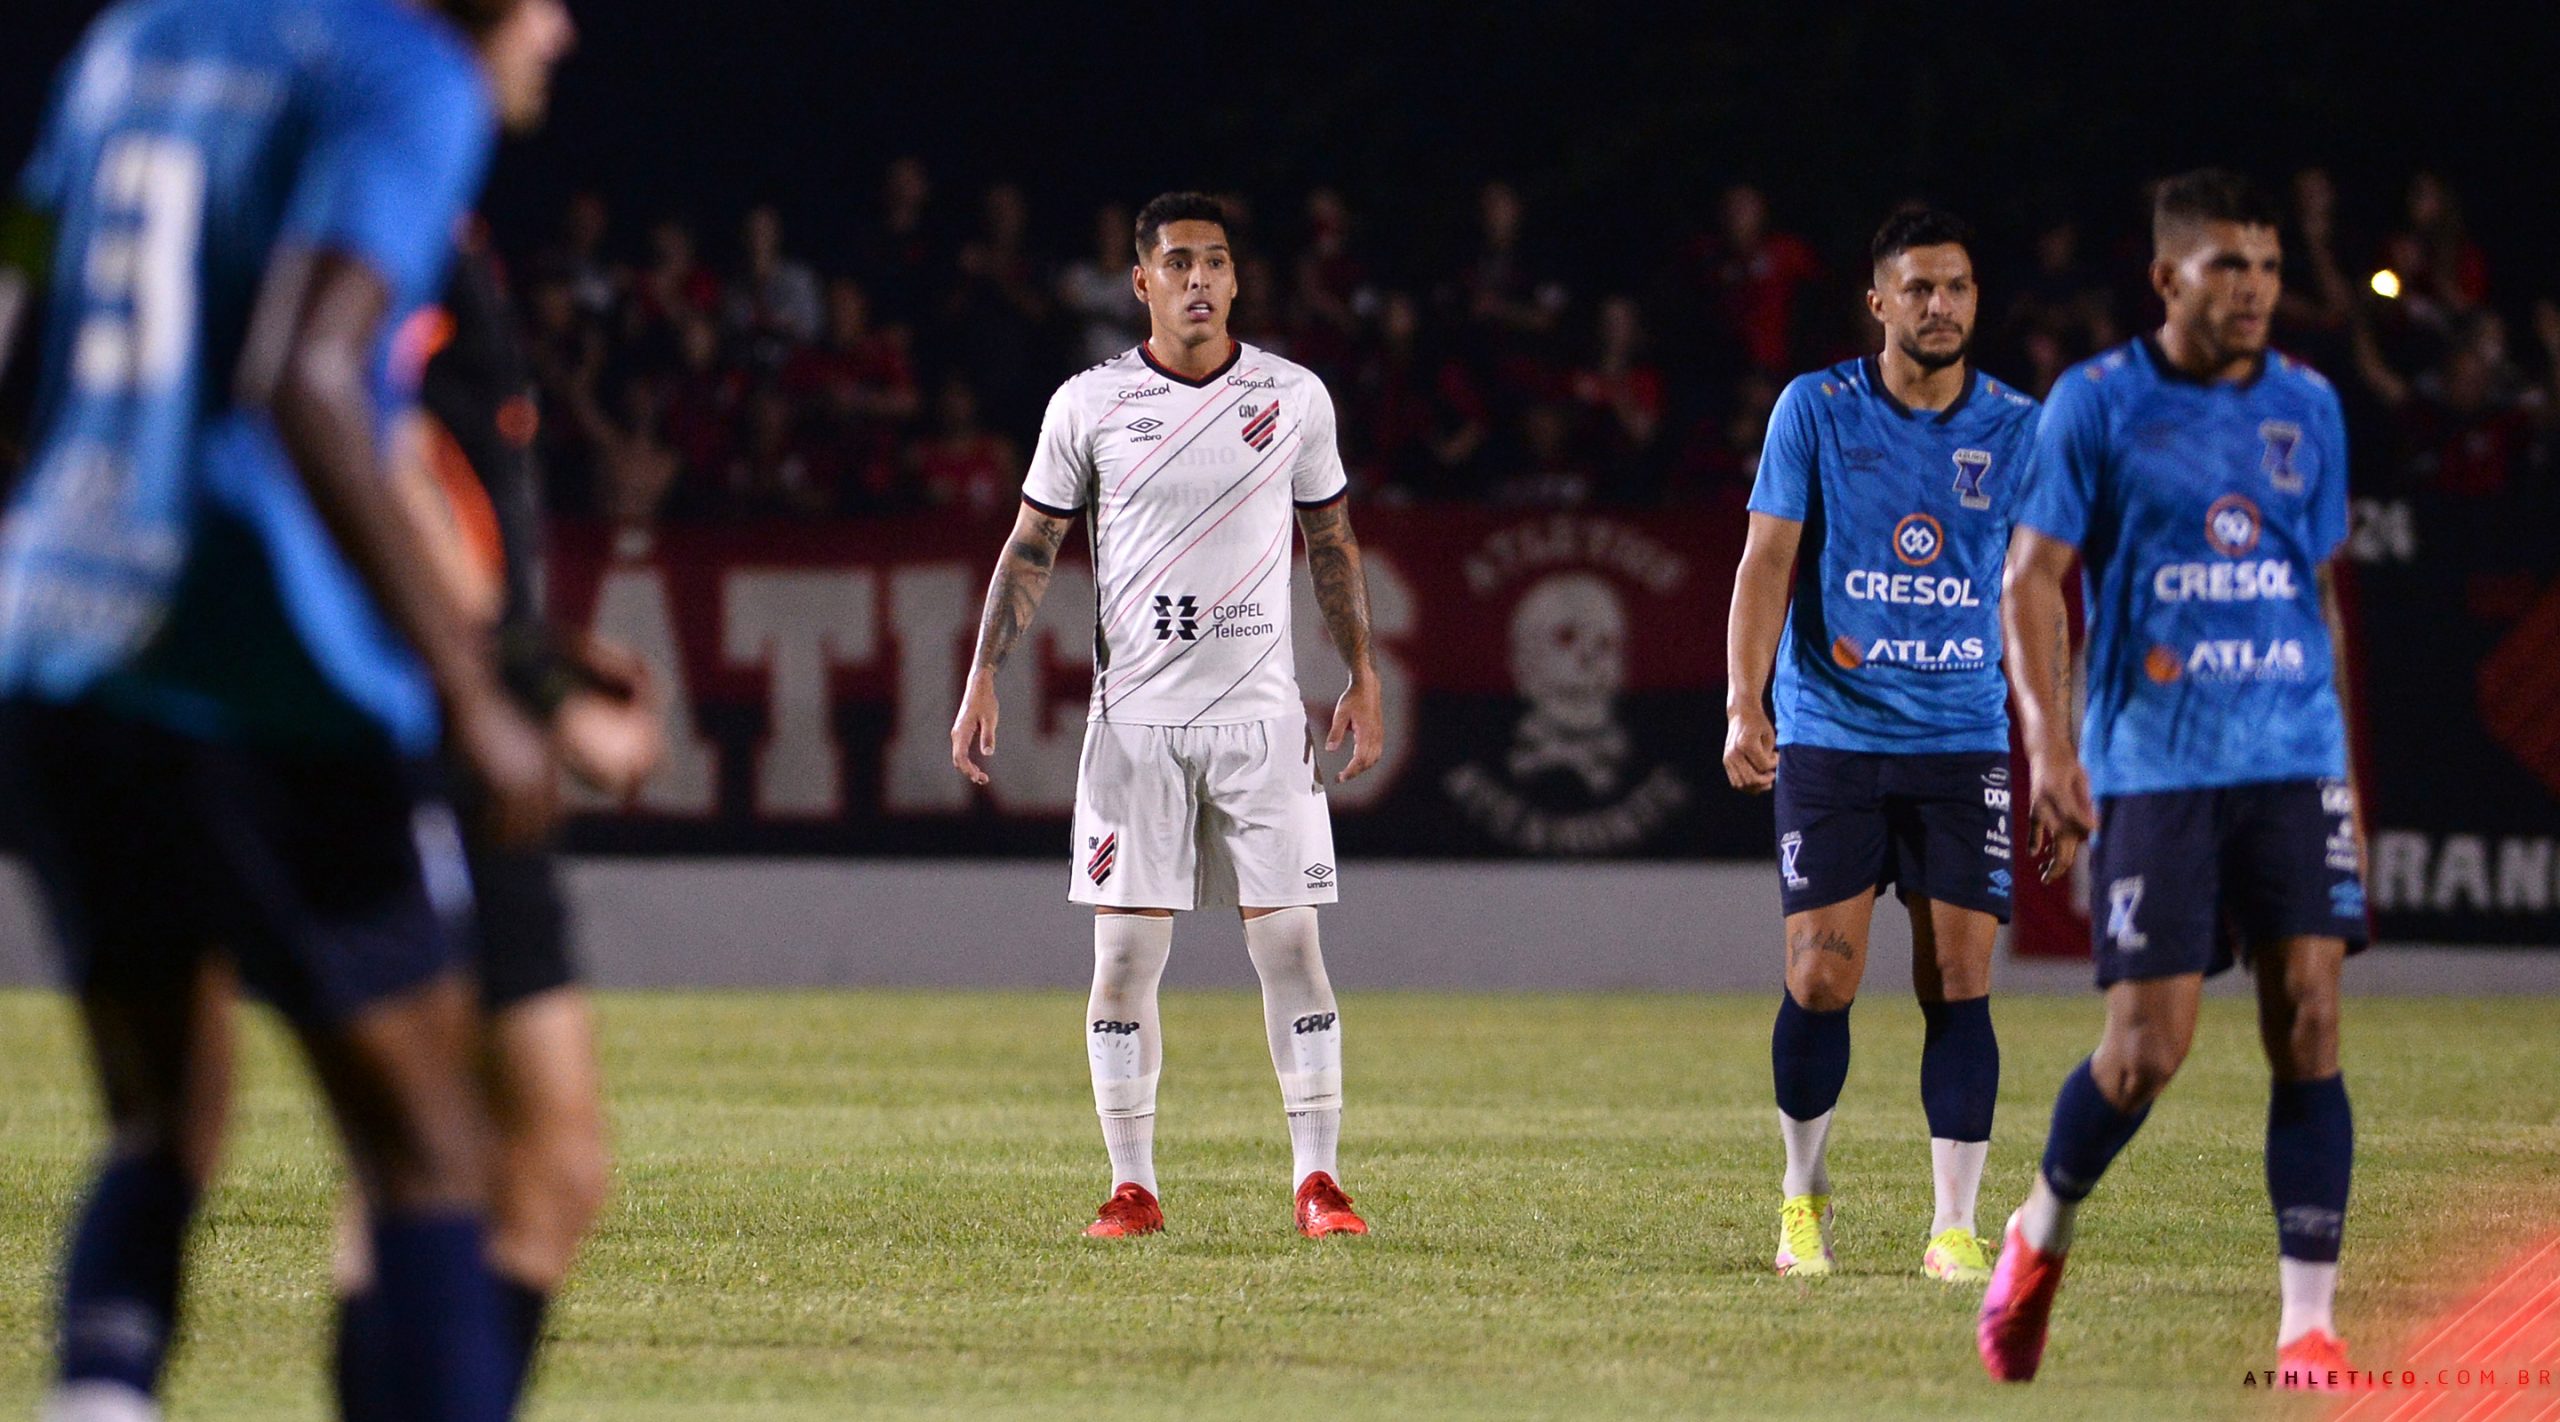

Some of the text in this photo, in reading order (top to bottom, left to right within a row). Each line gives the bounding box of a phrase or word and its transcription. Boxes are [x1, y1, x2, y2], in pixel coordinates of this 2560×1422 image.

[1118, 382, 1171, 400] Copacol
[1227, 375, 1275, 389] Copacol
[1130, 433, 1162, 443] umbro
[1845, 569, 1980, 608] CRESOL
[2153, 559, 2298, 602] CRESOL
[1213, 602, 1264, 620] COPEL
[1212, 623, 1273, 639] Telecom
[1866, 637, 1984, 663] ATLAS
[2187, 638, 2304, 672] ATLAS
[1306, 878, 1334, 889] umbro
